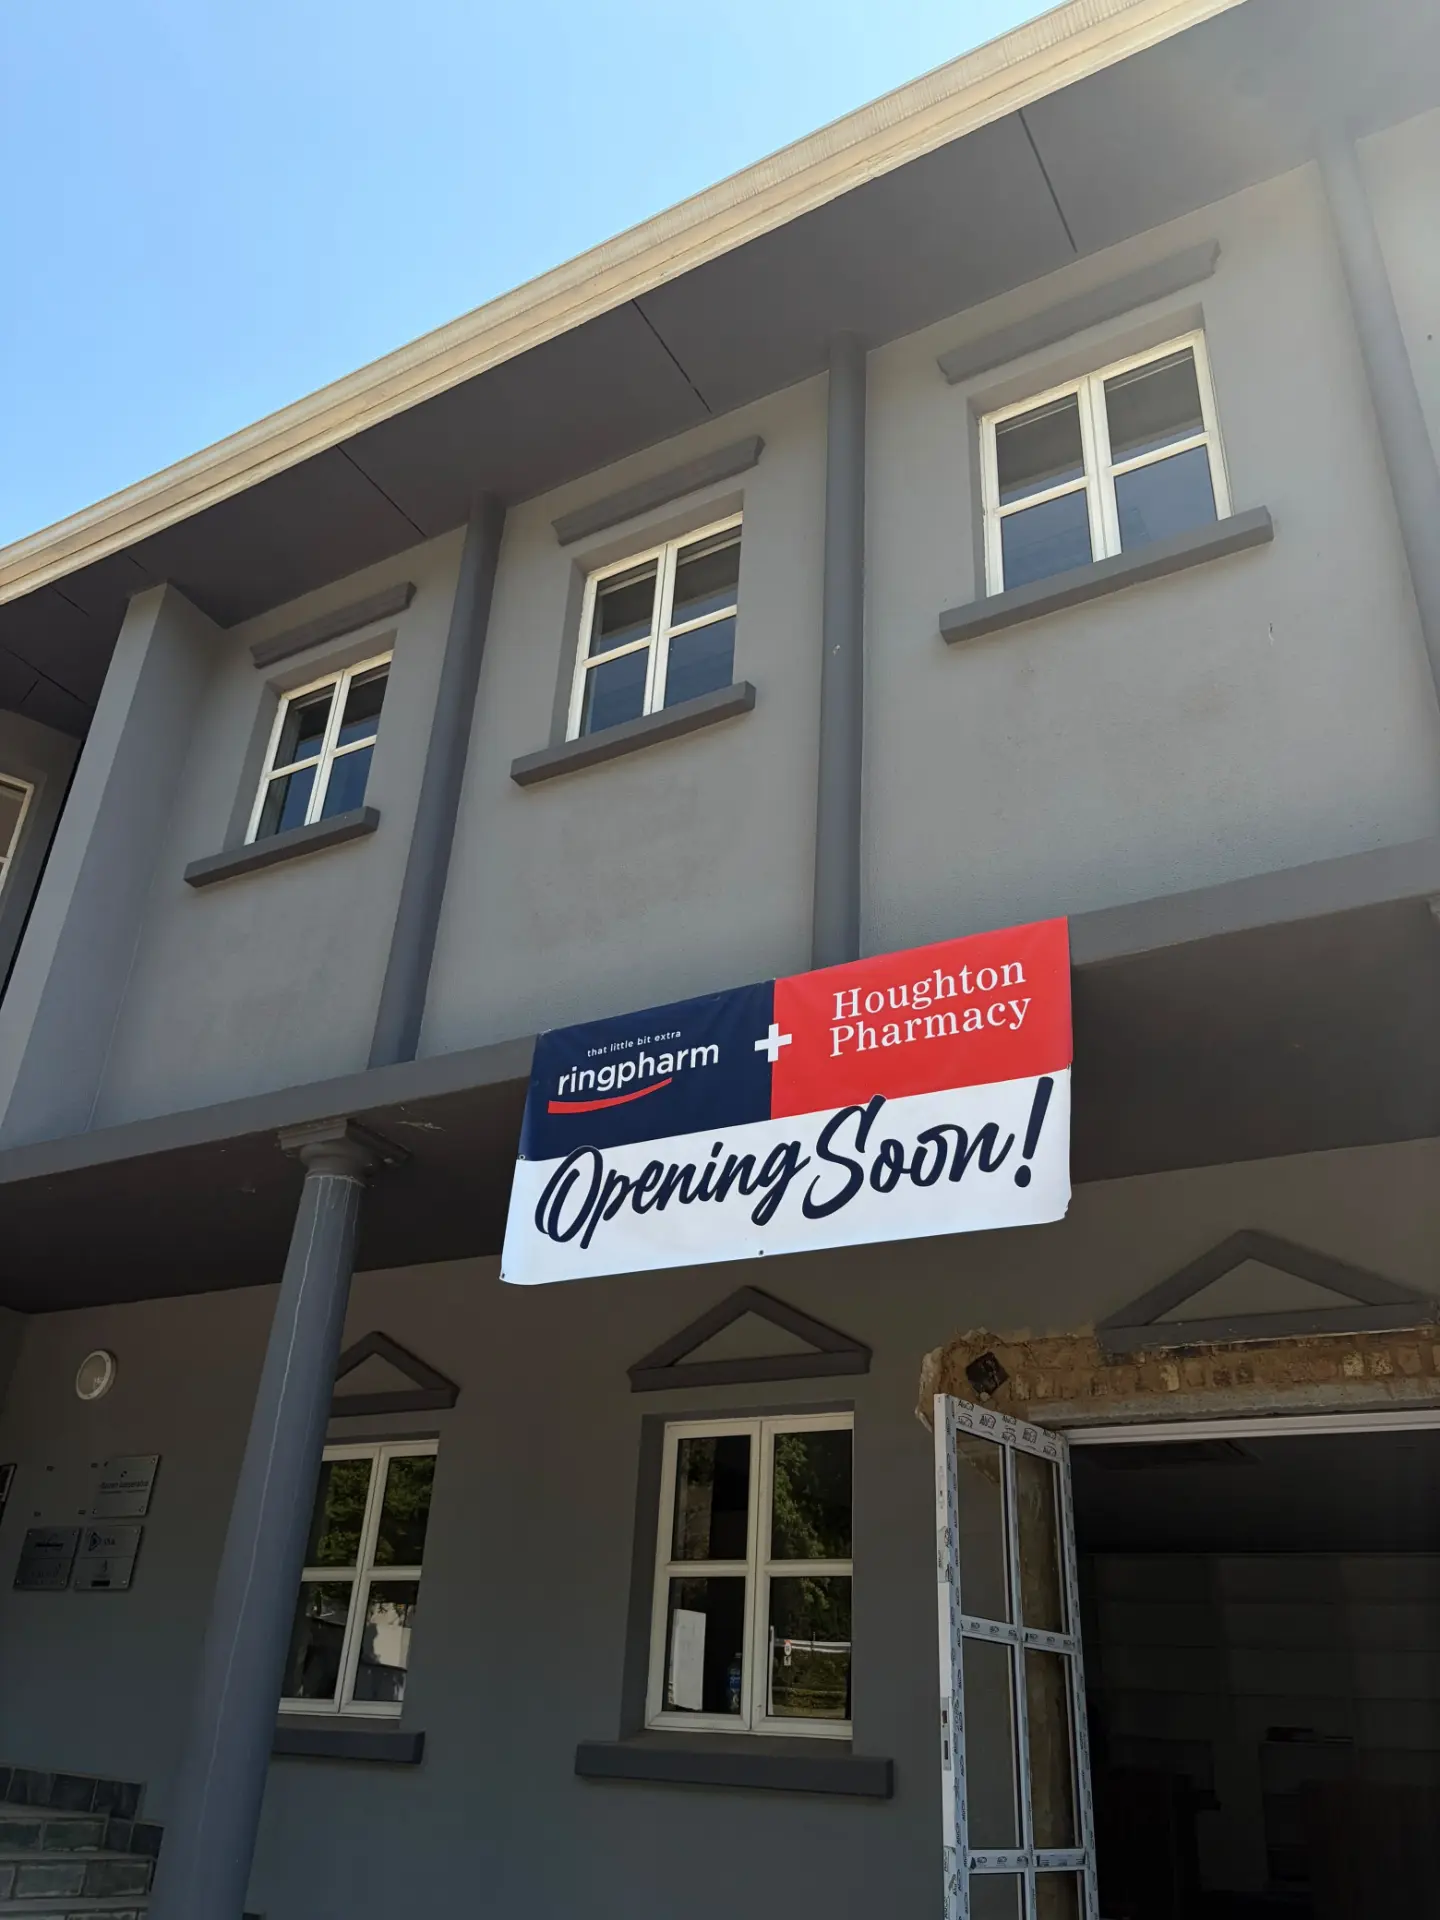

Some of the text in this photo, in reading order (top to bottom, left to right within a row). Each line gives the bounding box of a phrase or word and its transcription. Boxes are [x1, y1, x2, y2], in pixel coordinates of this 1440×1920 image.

[832, 960, 1026, 1021] Houghton
[587, 1031, 681, 1058] that little bit extra
[829, 997, 1032, 1058] Pharmacy
[557, 1043, 719, 1096] ringpharm
[534, 1076, 1054, 1249] Opening Soon!
